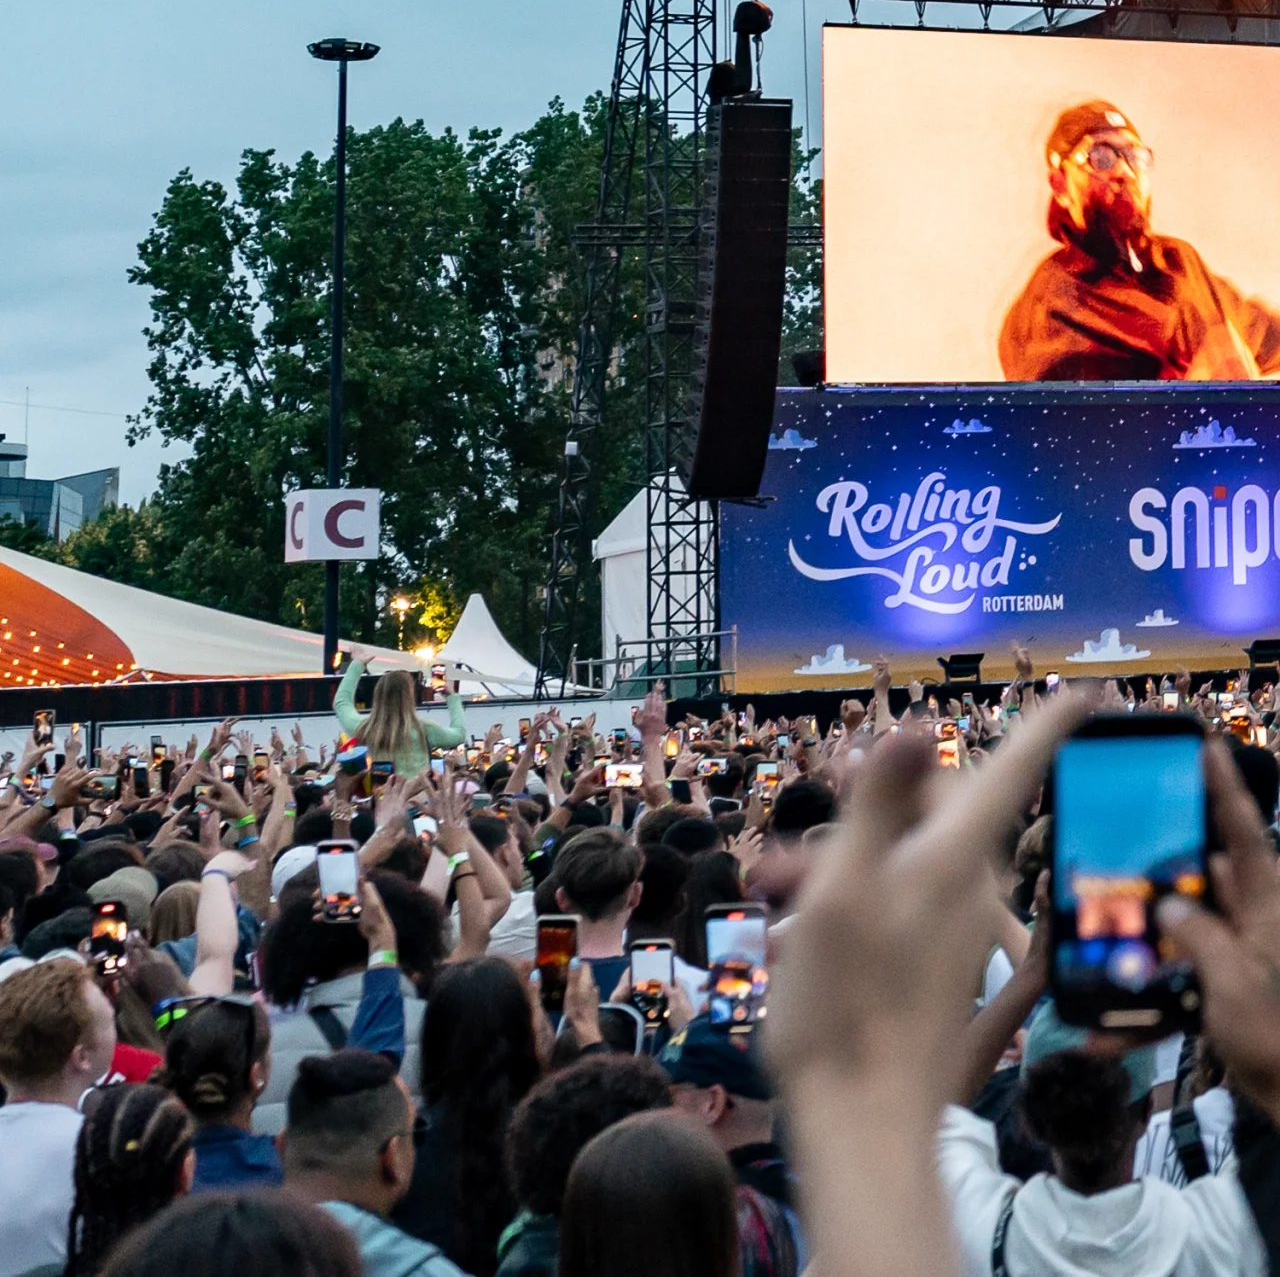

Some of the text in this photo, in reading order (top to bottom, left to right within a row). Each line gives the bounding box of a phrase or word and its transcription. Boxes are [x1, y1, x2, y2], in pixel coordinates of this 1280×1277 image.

[290, 501, 304, 550] C
[324, 500, 365, 549] C
[816, 472, 1063, 561] Rolling
[788, 535, 1017, 615] Loud
[982, 594, 1064, 613] ROTTERDAM
